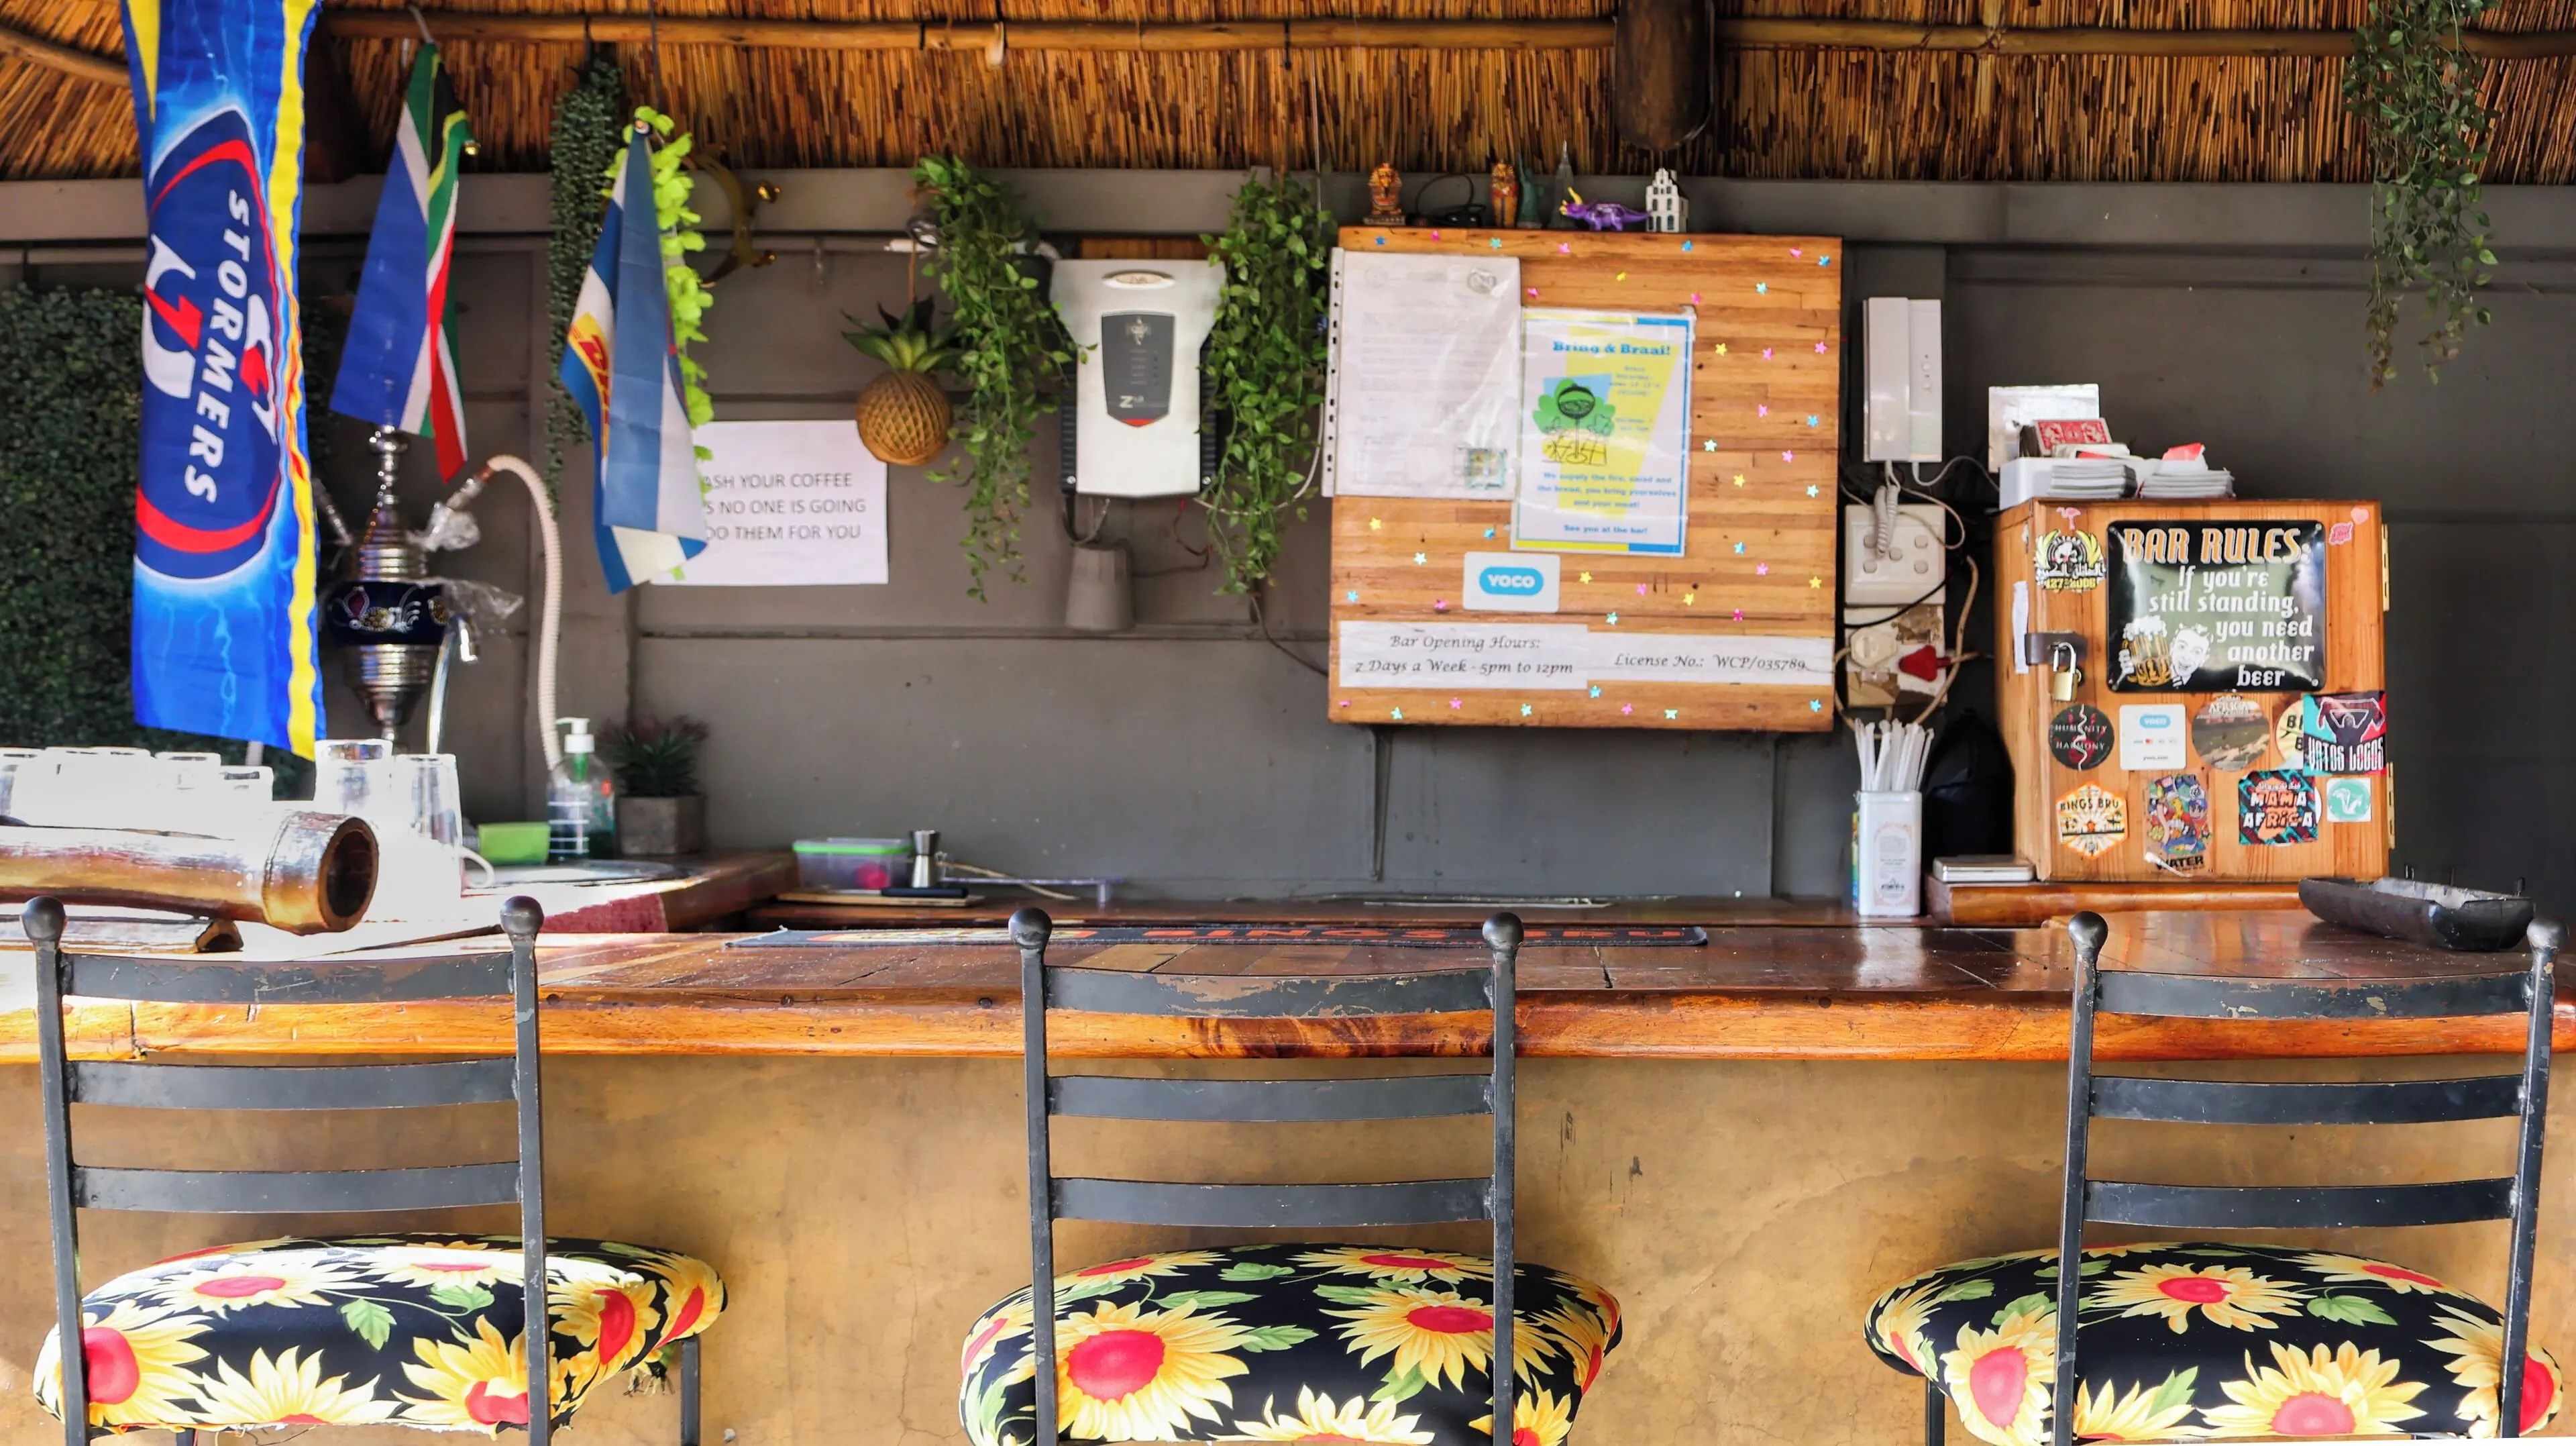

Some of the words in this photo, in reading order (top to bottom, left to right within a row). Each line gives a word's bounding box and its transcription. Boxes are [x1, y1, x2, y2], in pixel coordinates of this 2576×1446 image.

[185, 190, 251, 503] STORMERS
[1553, 340, 1599, 354] Bring
[1605, 343, 1615, 353] &
[1620, 343, 1670, 356] Braai!
[704, 474, 735, 488] ASH
[740, 473, 786, 488] YOUR
[790, 472, 853, 488] COFFEE
[720, 500, 745, 514] NO
[750, 499, 786, 514] ONE
[792, 499, 806, 514] IS
[810, 499, 866, 513] GOING
[706, 525, 729, 541] DO
[735, 525, 784, 540] THEM
[789, 525, 822, 539] FOR
[826, 525, 861, 539] YOU
[2123, 527, 2190, 564] BAR
[1487, 574, 1536, 588] YOCO
[2178, 565, 2196, 592] If
[2203, 565, 2269, 592] you're
[2149, 590, 2190, 612] still
[2198, 590, 2299, 618] standing,
[2216, 621, 2253, 642] you
[2262, 615, 2314, 637] need
[1390, 635, 1419, 648] Bar
[1423, 635, 1485, 652] Opening
[1489, 635, 1541, 649] Hours:
[2227, 639, 2314, 662] another
[1368, 659, 1407, 675] Days
[1412, 662, 1421, 672] a
[1426, 658, 1467, 672] Week
[1480, 662, 1511, 677] 5pm
[1517, 661, 1532, 673] to
[1536, 663, 1574, 678] 12pm
[1614, 653, 1668, 667] License
[1712, 654, 1806, 671] WCP/035789
[2237, 664, 2286, 686] beer
[2055, 725, 2107, 733] HUMNITY
[2308, 736, 2345, 771] VATOS
[2250, 791, 2307, 807] MAMA
